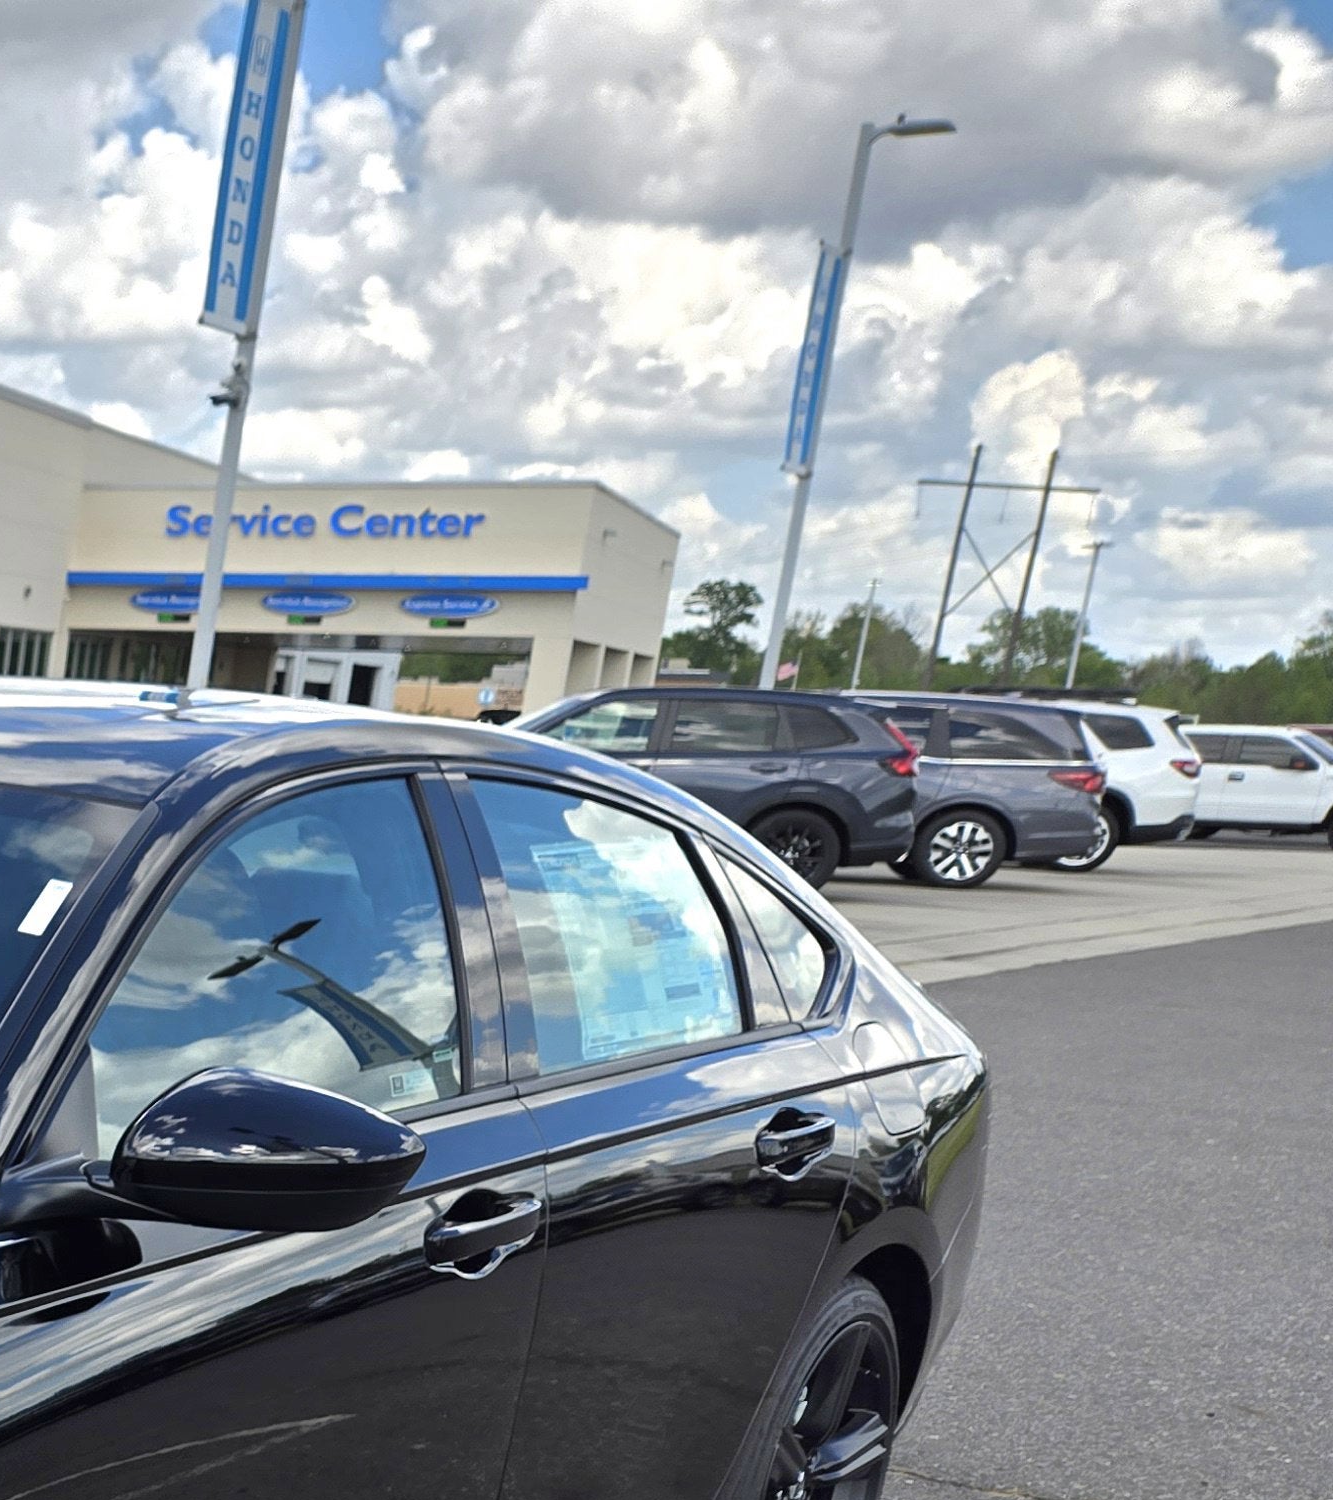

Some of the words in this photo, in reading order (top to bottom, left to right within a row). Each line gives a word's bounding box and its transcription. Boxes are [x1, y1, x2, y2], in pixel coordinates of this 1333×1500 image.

[221, 91, 262, 288] HONDA
[165, 503, 316, 538] Sevice
[329, 503, 486, 538] Center
